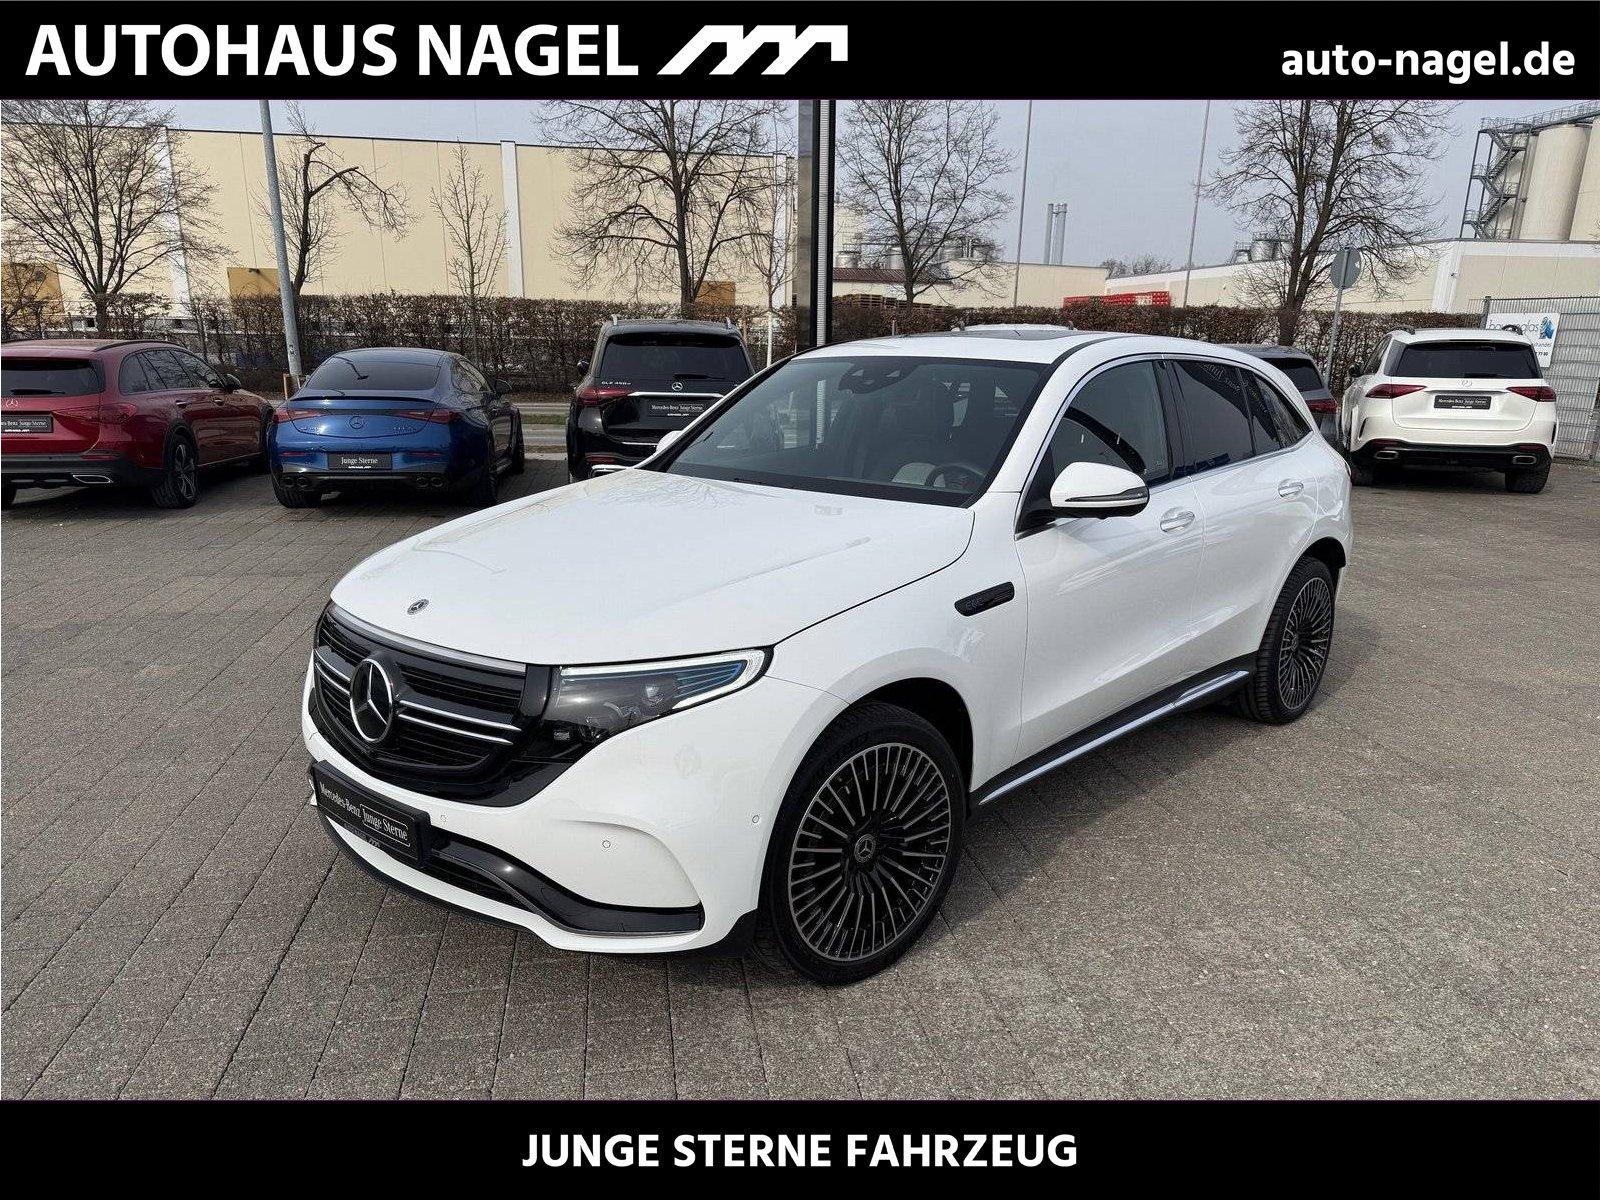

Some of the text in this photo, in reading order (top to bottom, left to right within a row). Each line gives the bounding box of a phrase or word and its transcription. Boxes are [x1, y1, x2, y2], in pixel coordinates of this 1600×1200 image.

[341, 456, 358, 465] Junge
[320, 781, 362, 818] Mercedes-Benz
[362, 808, 382, 830] Junge
[382, 818, 408, 840] Sterne
